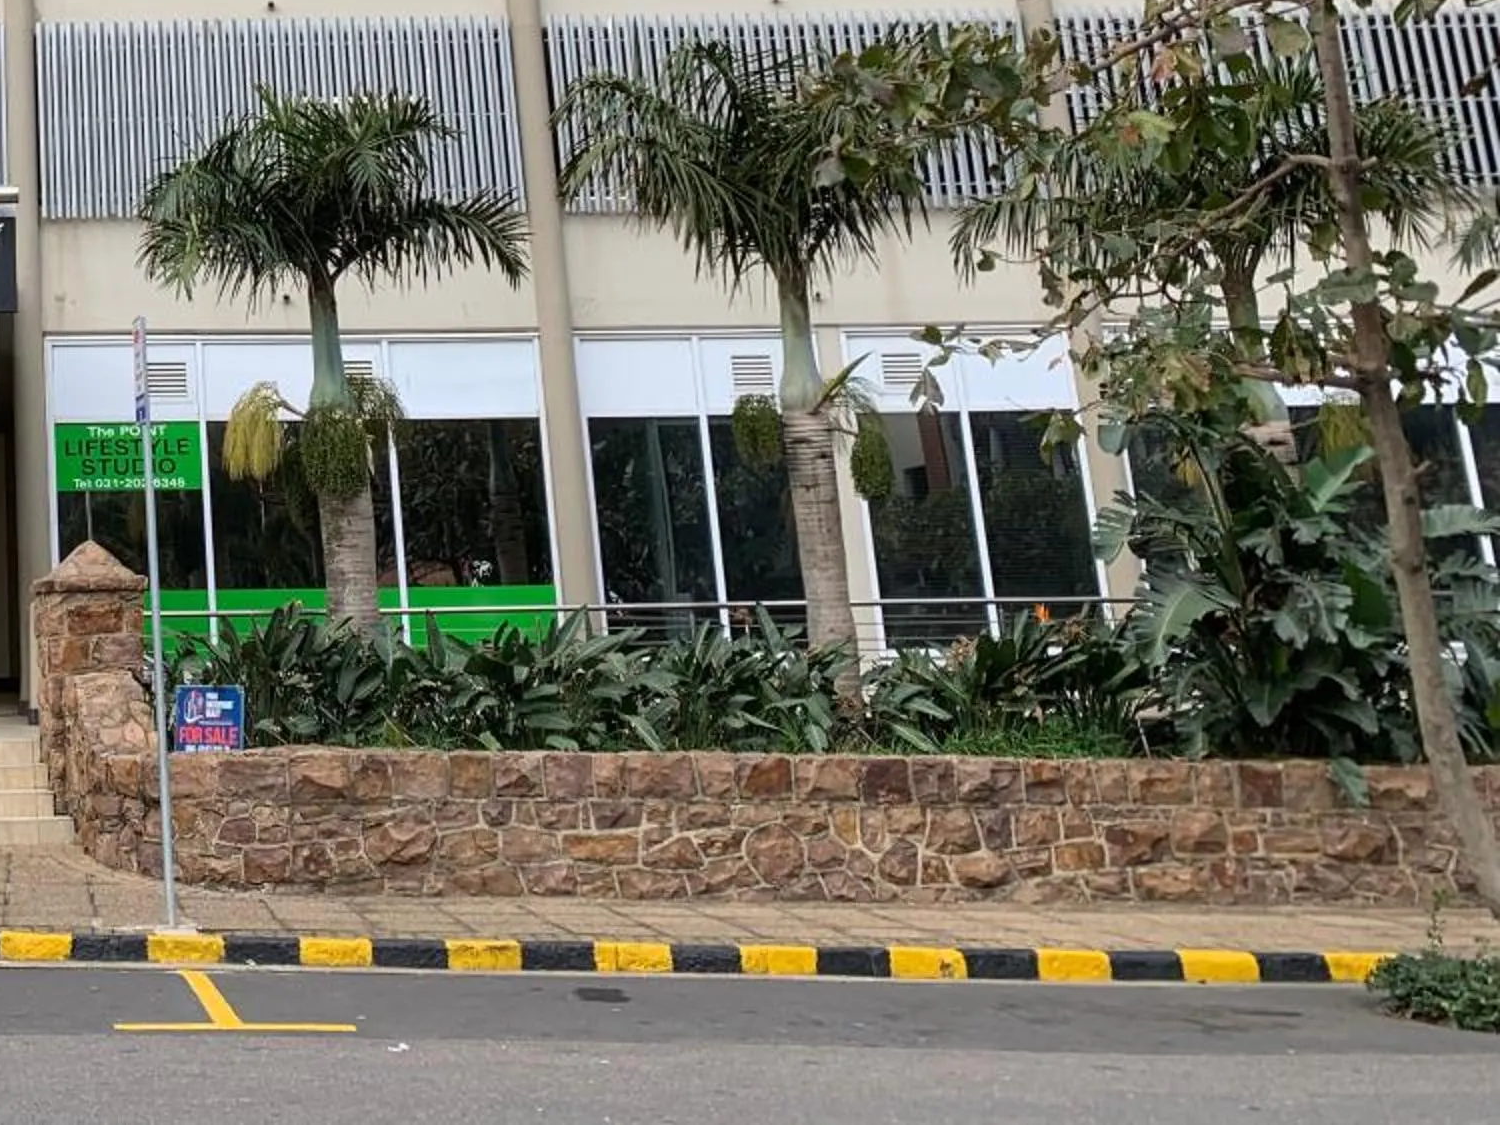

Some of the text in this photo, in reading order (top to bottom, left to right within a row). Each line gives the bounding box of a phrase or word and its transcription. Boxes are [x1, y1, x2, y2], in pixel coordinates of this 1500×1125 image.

[87, 425, 167, 438] The PONT
[65, 438, 189, 457] LIFESTYLE
[82, 458, 176, 476] STUDIO
[180, 726, 238, 743] FOR SALE
